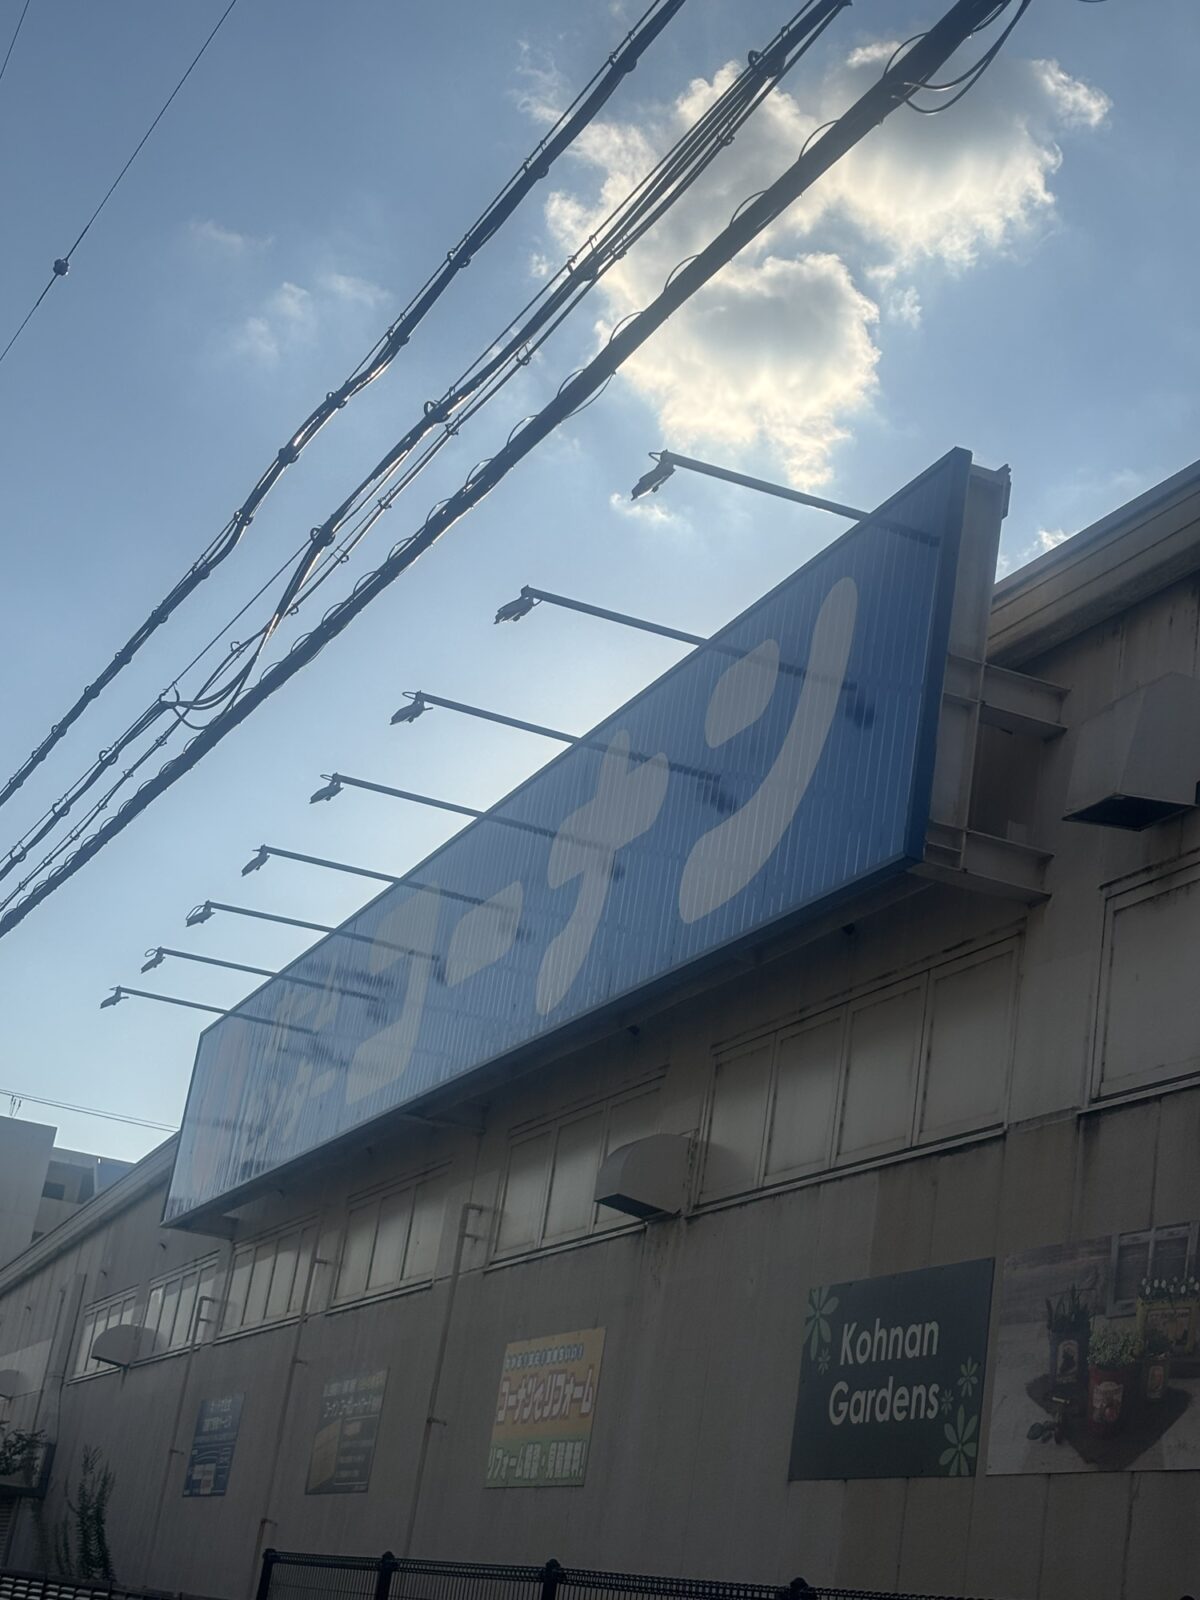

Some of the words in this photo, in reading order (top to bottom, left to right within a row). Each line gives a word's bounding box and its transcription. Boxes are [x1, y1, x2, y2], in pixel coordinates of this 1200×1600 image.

[345, 577, 858, 1104] コーナン
[840, 1317, 940, 1366] Kohnan
[829, 1376, 940, 1426] Gardens
